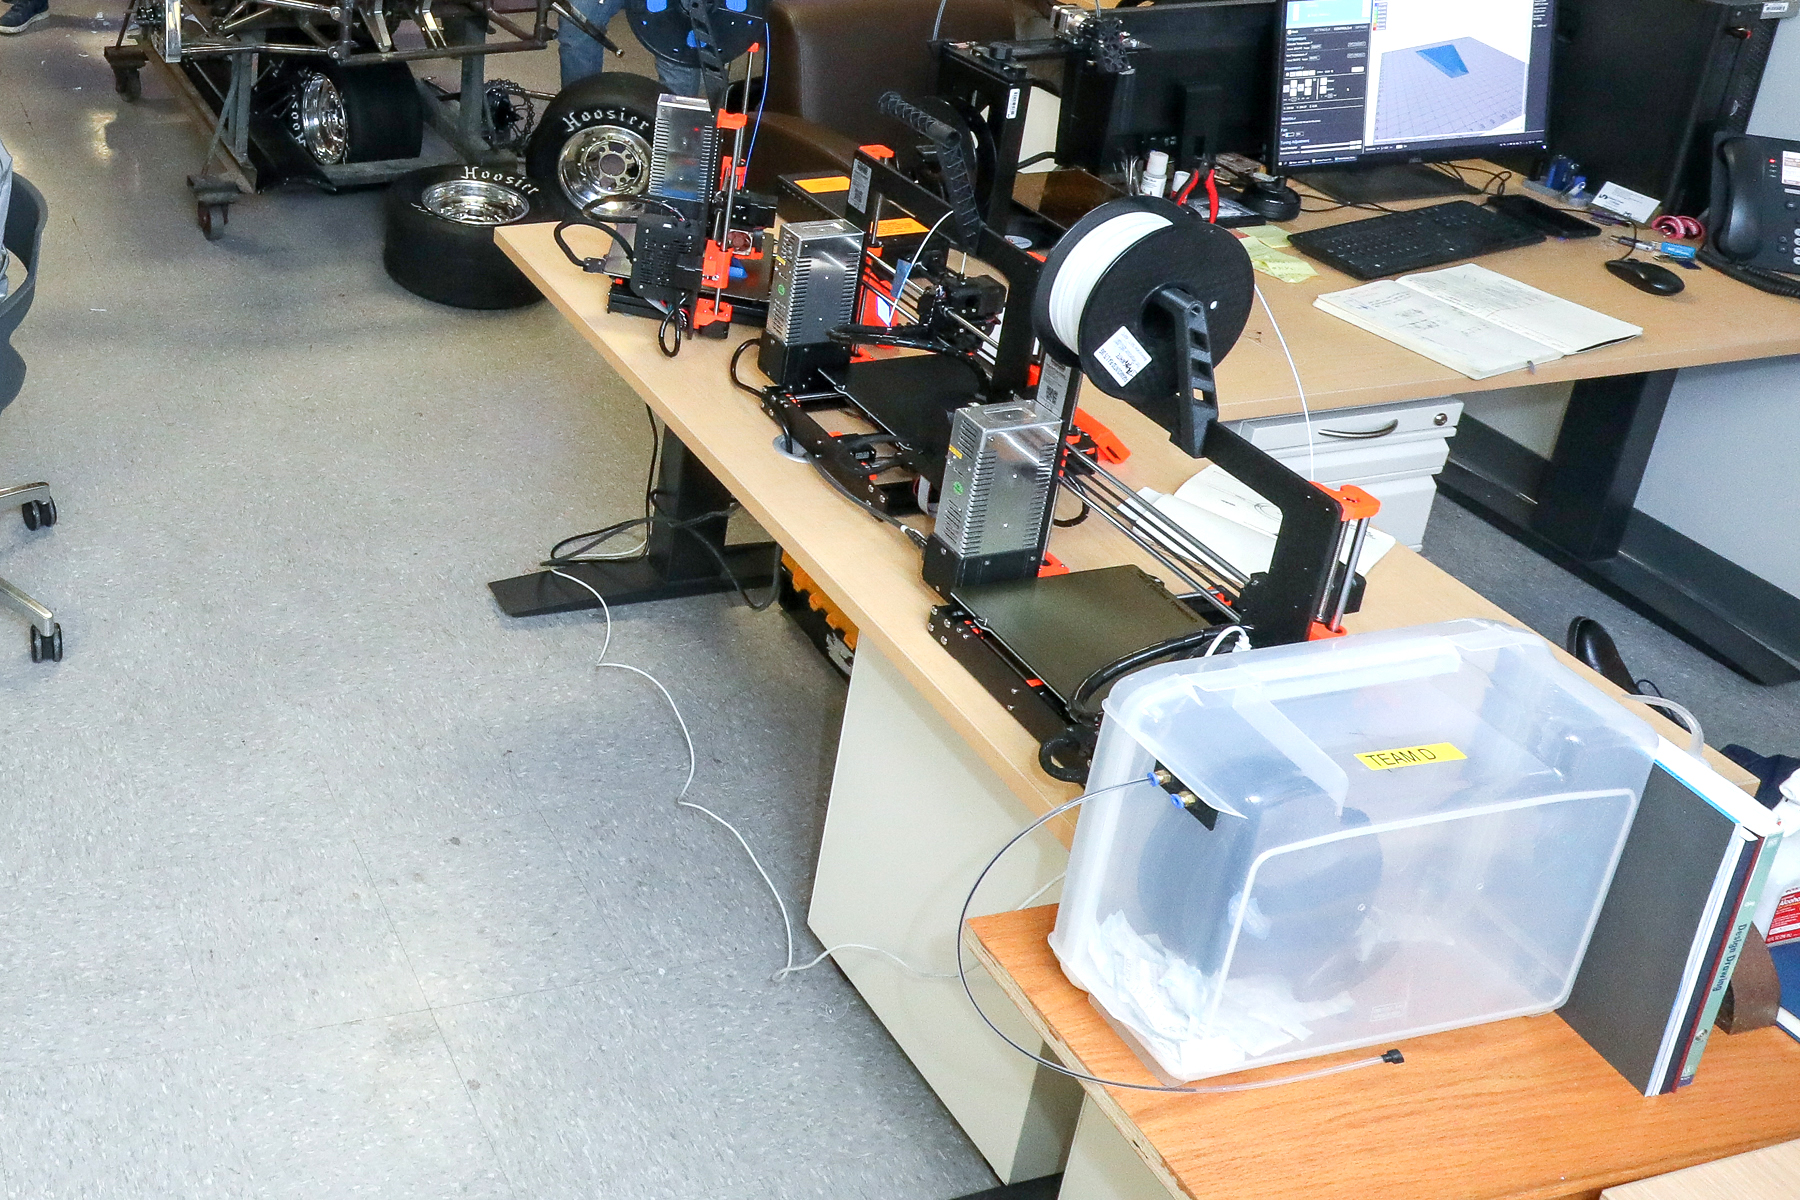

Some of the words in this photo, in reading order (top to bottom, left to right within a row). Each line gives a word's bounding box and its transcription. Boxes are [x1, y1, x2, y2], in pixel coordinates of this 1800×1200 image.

[562, 107, 650, 133] Hoosier
[460, 165, 540, 195] Hoosier
[1365, 750, 1422, 767] TEAM
[1728, 923, 1747, 954] Design
[1712, 954, 1736, 992] Drawing
